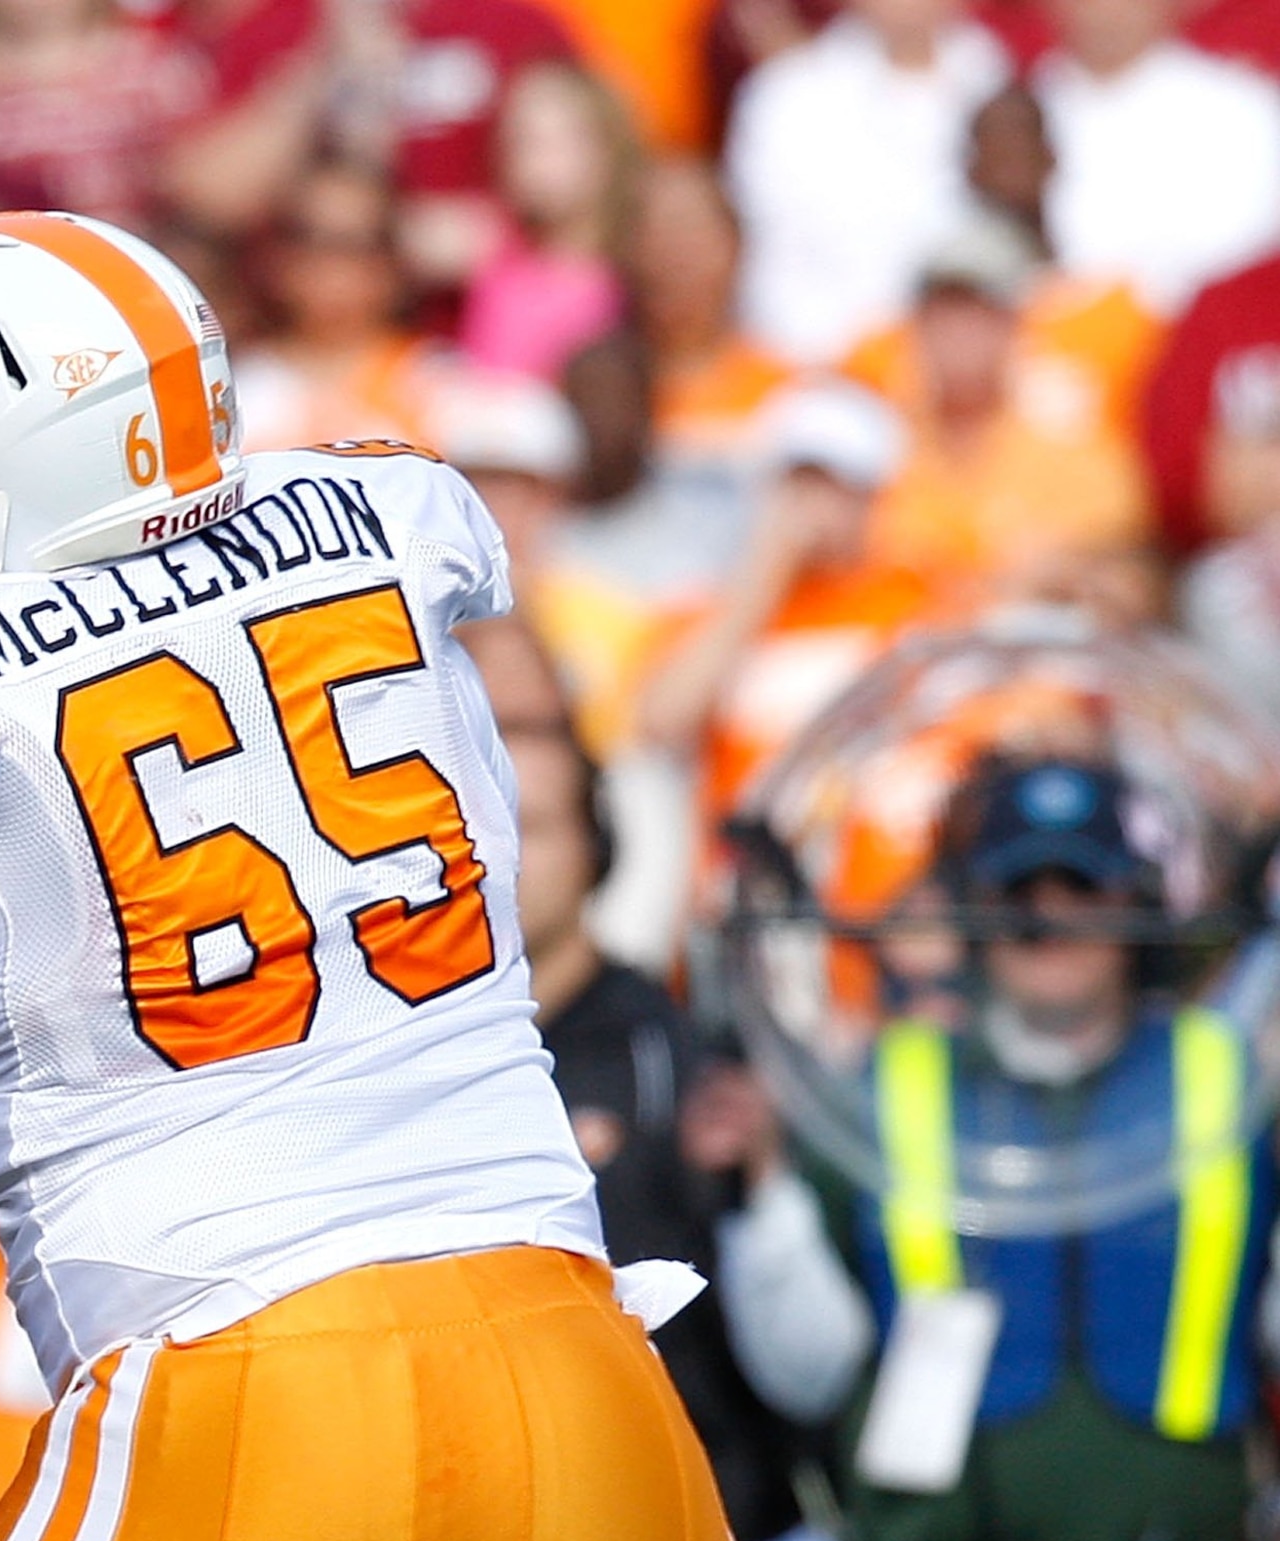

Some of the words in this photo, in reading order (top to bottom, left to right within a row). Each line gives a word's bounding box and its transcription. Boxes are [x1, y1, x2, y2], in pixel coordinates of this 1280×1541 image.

[66, 354, 101, 384] SEC
[125, 412, 158, 487] 6
[141, 481, 245, 544] Riddell
[55, 581, 496, 1072] 65
